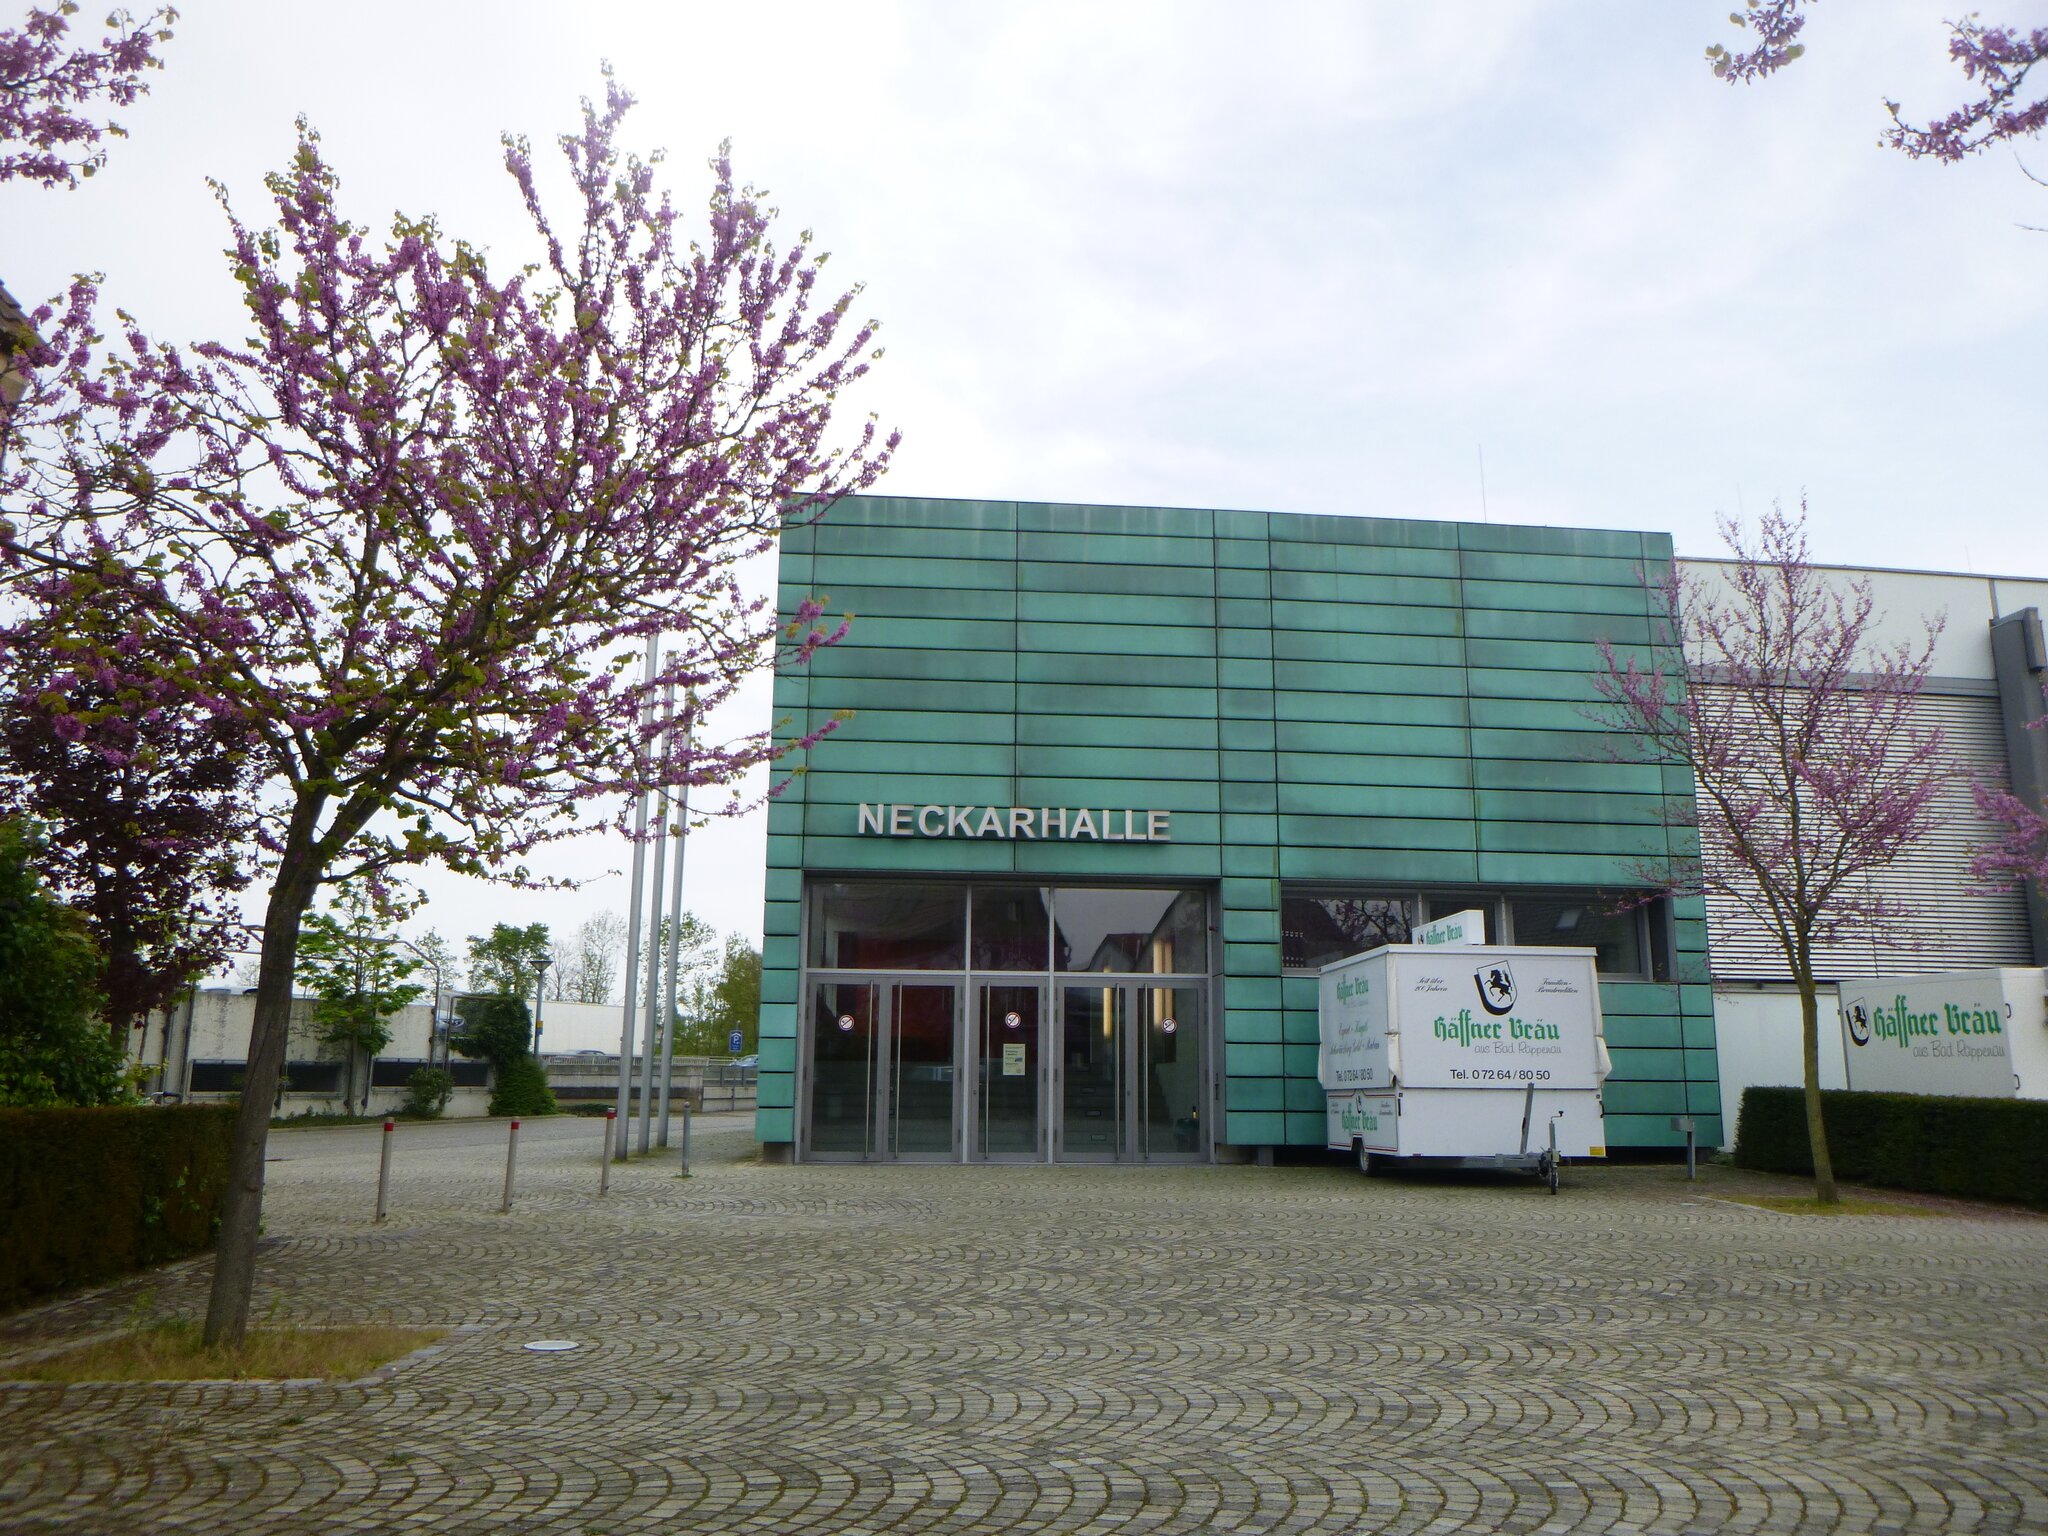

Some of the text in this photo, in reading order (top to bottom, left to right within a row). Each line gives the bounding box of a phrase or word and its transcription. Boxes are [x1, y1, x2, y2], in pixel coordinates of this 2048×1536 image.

[858, 803, 1171, 841] NECKARHALLE
[1434, 1008, 1560, 1047] Häffner Bräu
[1873, 995, 2002, 1047] Häffner Bräu
[1474, 1041, 1562, 1056] aus Bad Rappenau
[1912, 1039, 2005, 1062] aus Bad Rappenau
[1450, 1069, 1469, 1080] Tel.
